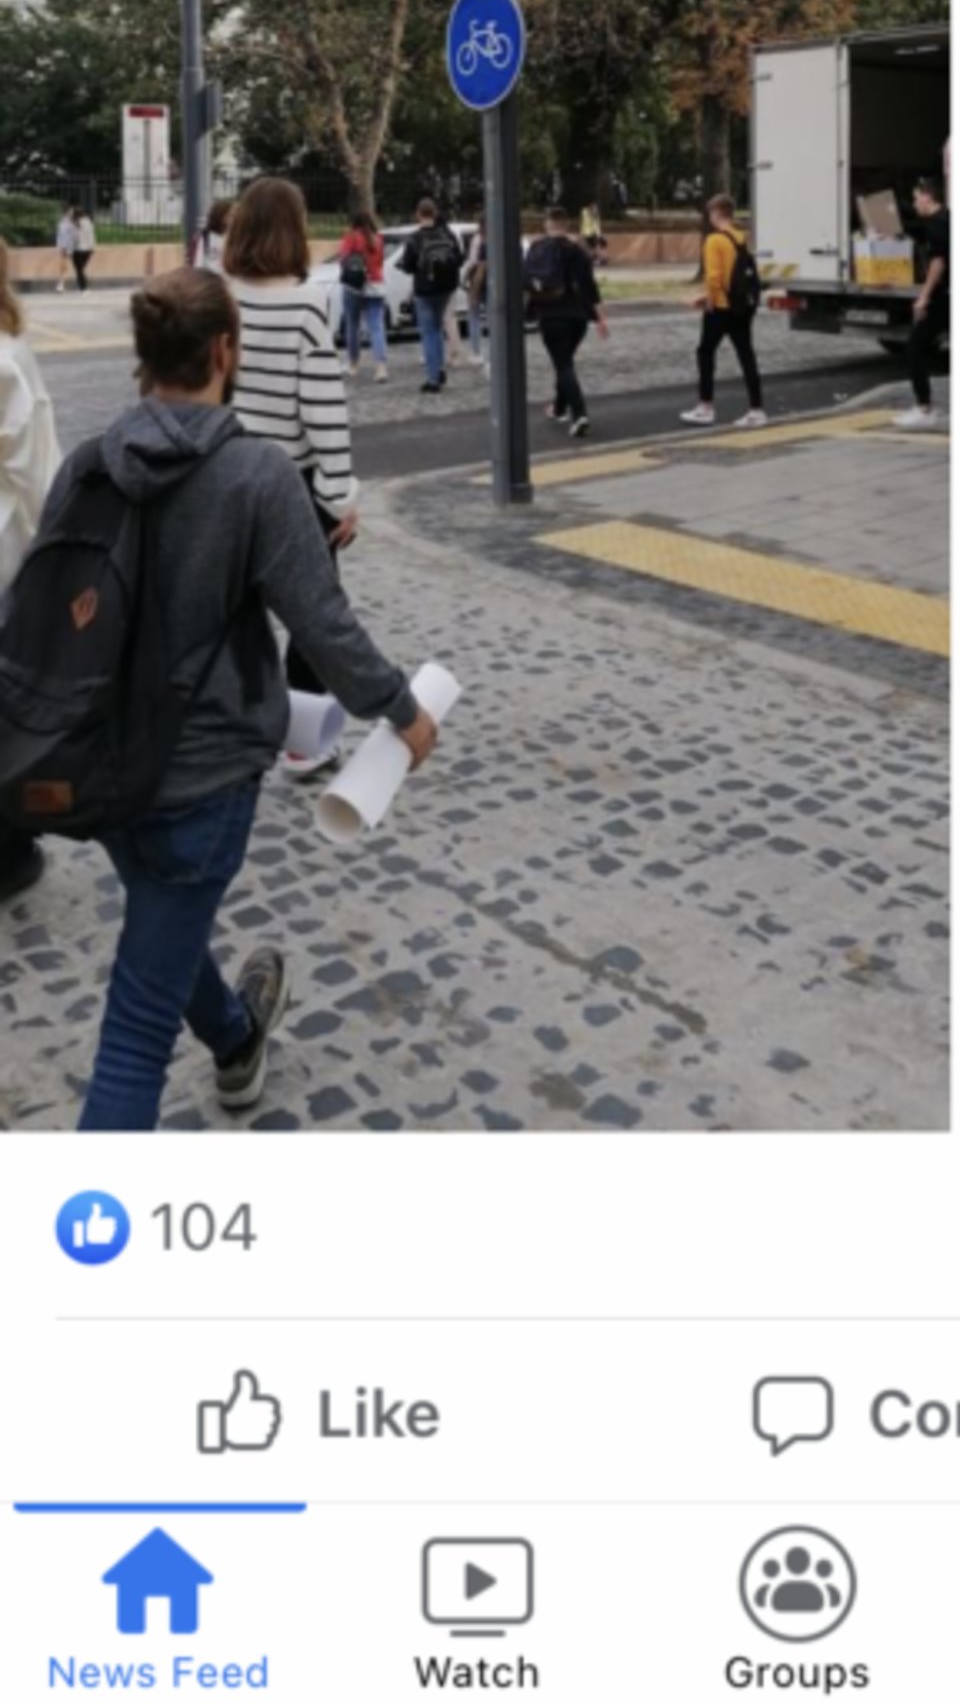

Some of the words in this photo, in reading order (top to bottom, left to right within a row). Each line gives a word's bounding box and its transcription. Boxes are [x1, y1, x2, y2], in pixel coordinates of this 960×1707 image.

[153, 1203, 256, 1251] 104
[321, 1387, 439, 1437] Like
[49, 1657, 155, 1688] News
[173, 1656, 267, 1688] Feed
[414, 1656, 538, 1688] Watch
[725, 1656, 869, 1694] Groups
